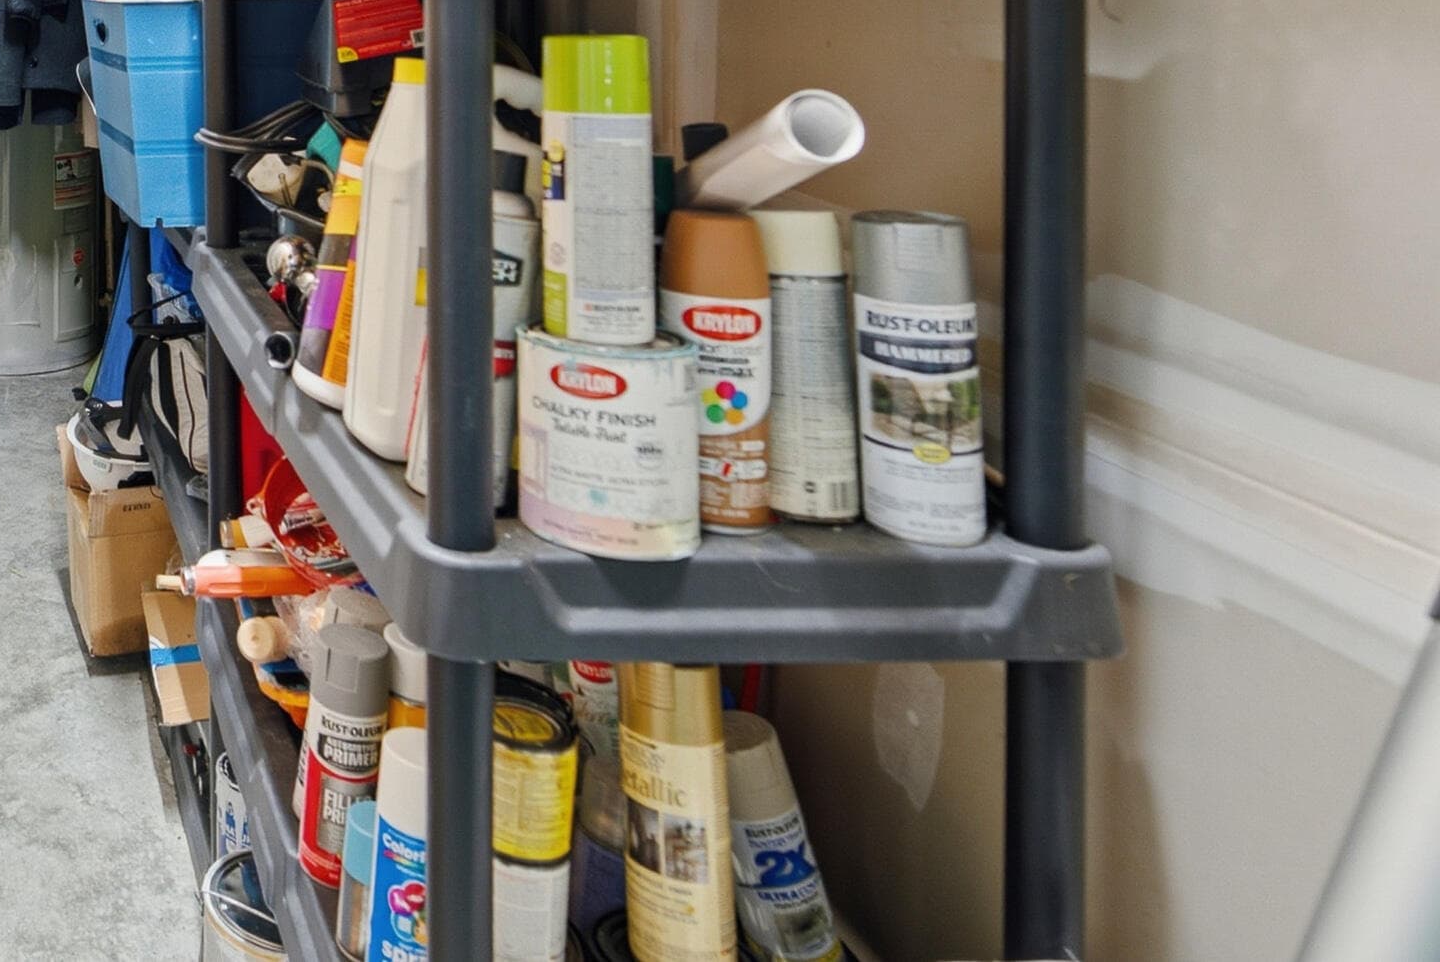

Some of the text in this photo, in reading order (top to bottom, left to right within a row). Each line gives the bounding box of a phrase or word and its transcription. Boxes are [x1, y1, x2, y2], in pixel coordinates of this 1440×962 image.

[692, 310, 755, 335] KRYLON
[558, 369, 618, 395] KRYLON
[532, 395, 657, 428] CHALKY FINISH
[576, 662, 610, 679] KRYLO
[321, 715, 384, 739] RUST-OLEUM
[323, 747, 377, 768] PRIMER
[754, 840, 816, 889] 2X
